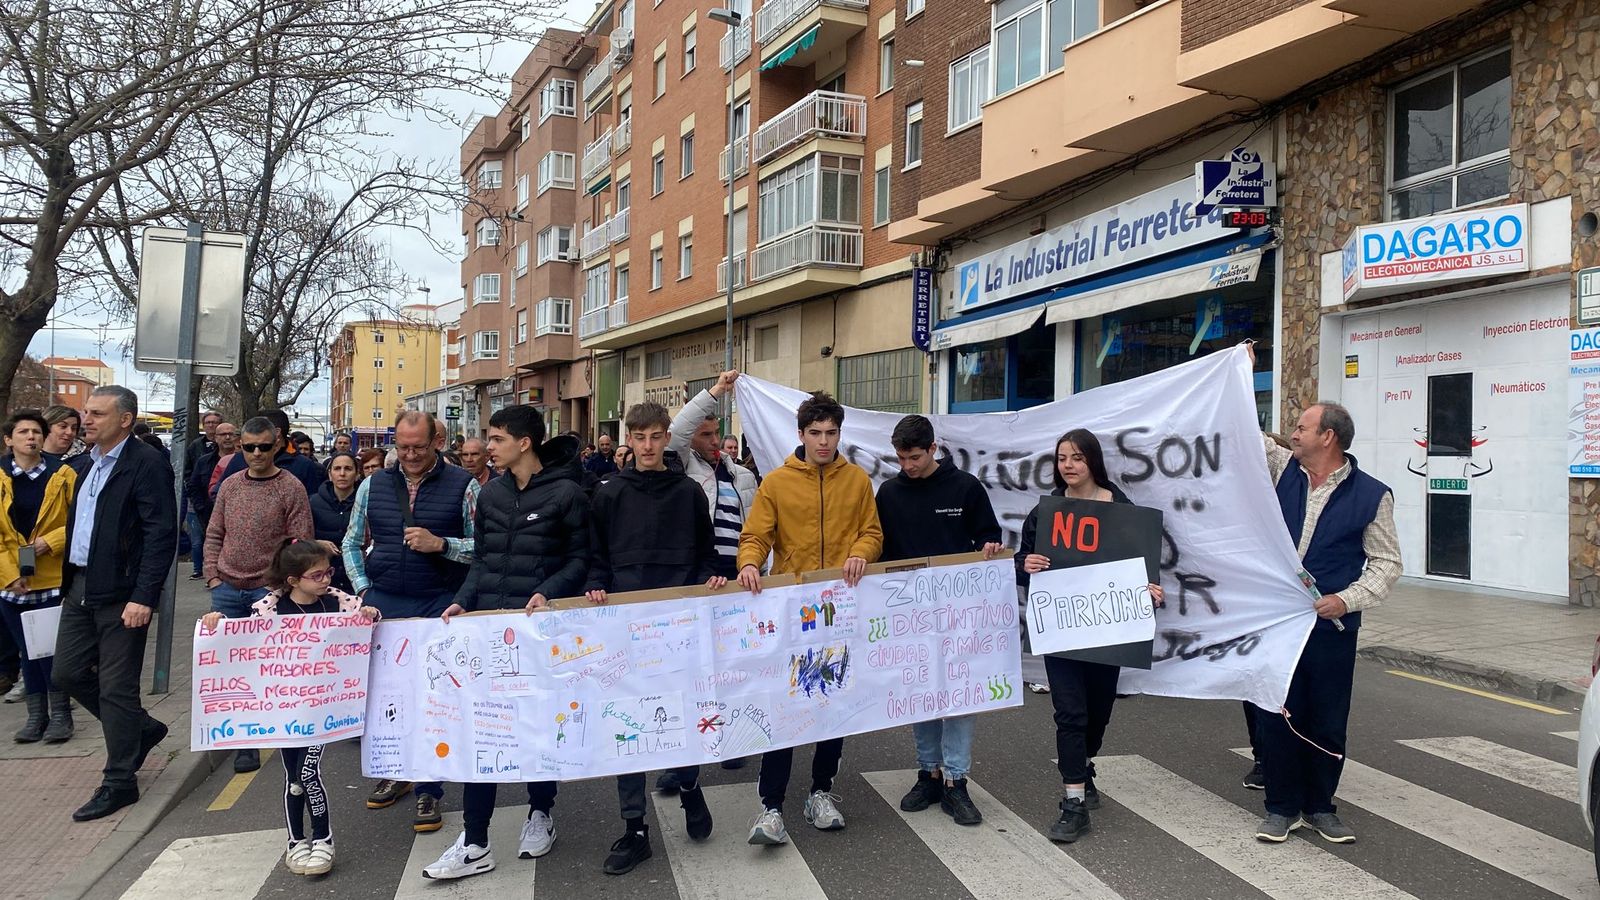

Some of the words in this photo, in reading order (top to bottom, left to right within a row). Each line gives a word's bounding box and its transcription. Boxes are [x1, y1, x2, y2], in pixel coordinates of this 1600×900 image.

[1227, 179, 1272, 187] Industrial
[1215, 190, 1259, 199] Ferretera
[1363, 215, 1522, 264] DAGARO
[984, 263, 1004, 294] La
[1008, 226, 1098, 287] Industrial
[1366, 258, 1470, 278] ELECTROMECÁNICA
[1394, 323, 1422, 337] General
[1485, 321, 1527, 338] Inyección
[1398, 352, 1435, 365] Analizador
[1437, 351, 1462, 362] Gases
[1386, 391, 1399, 401] Pre
[1400, 390, 1412, 400] ITV
[1493, 380, 1546, 394] Neumáticos
[1116, 426, 1221, 484] SON
[1431, 480, 1467, 489] ABIERTO
[1052, 511, 1099, 552] NO
[881, 565, 1001, 608] ZAMORA
[1030, 581, 1154, 634] PARKING
[224, 619, 273, 636] FUTURO
[280, 616, 304, 630] SON
[310, 614, 372, 628] NUESTROS
[199, 651, 220, 666] EL
[229, 646, 312, 663] PRESENTE
[867, 644, 930, 668] CIUDAD
[942, 630, 1009, 657] AMIGA
[260, 661, 340, 677] MAYORES.
[601, 664, 626, 688] STOP
[903, 665, 929, 685] DE
[948, 662, 970, 681] LA
[199, 676, 251, 695] ELLOS
[265, 682, 336, 698] MERECEN
[344, 678, 361, 689] SU
[204, 700, 274, 714] ESPACIO
[309, 691, 366, 709] DIGNIDAD
[887, 682, 985, 719] INFANCIA
[239, 723, 276, 736] TODO
[285, 719, 315, 735] VALE
